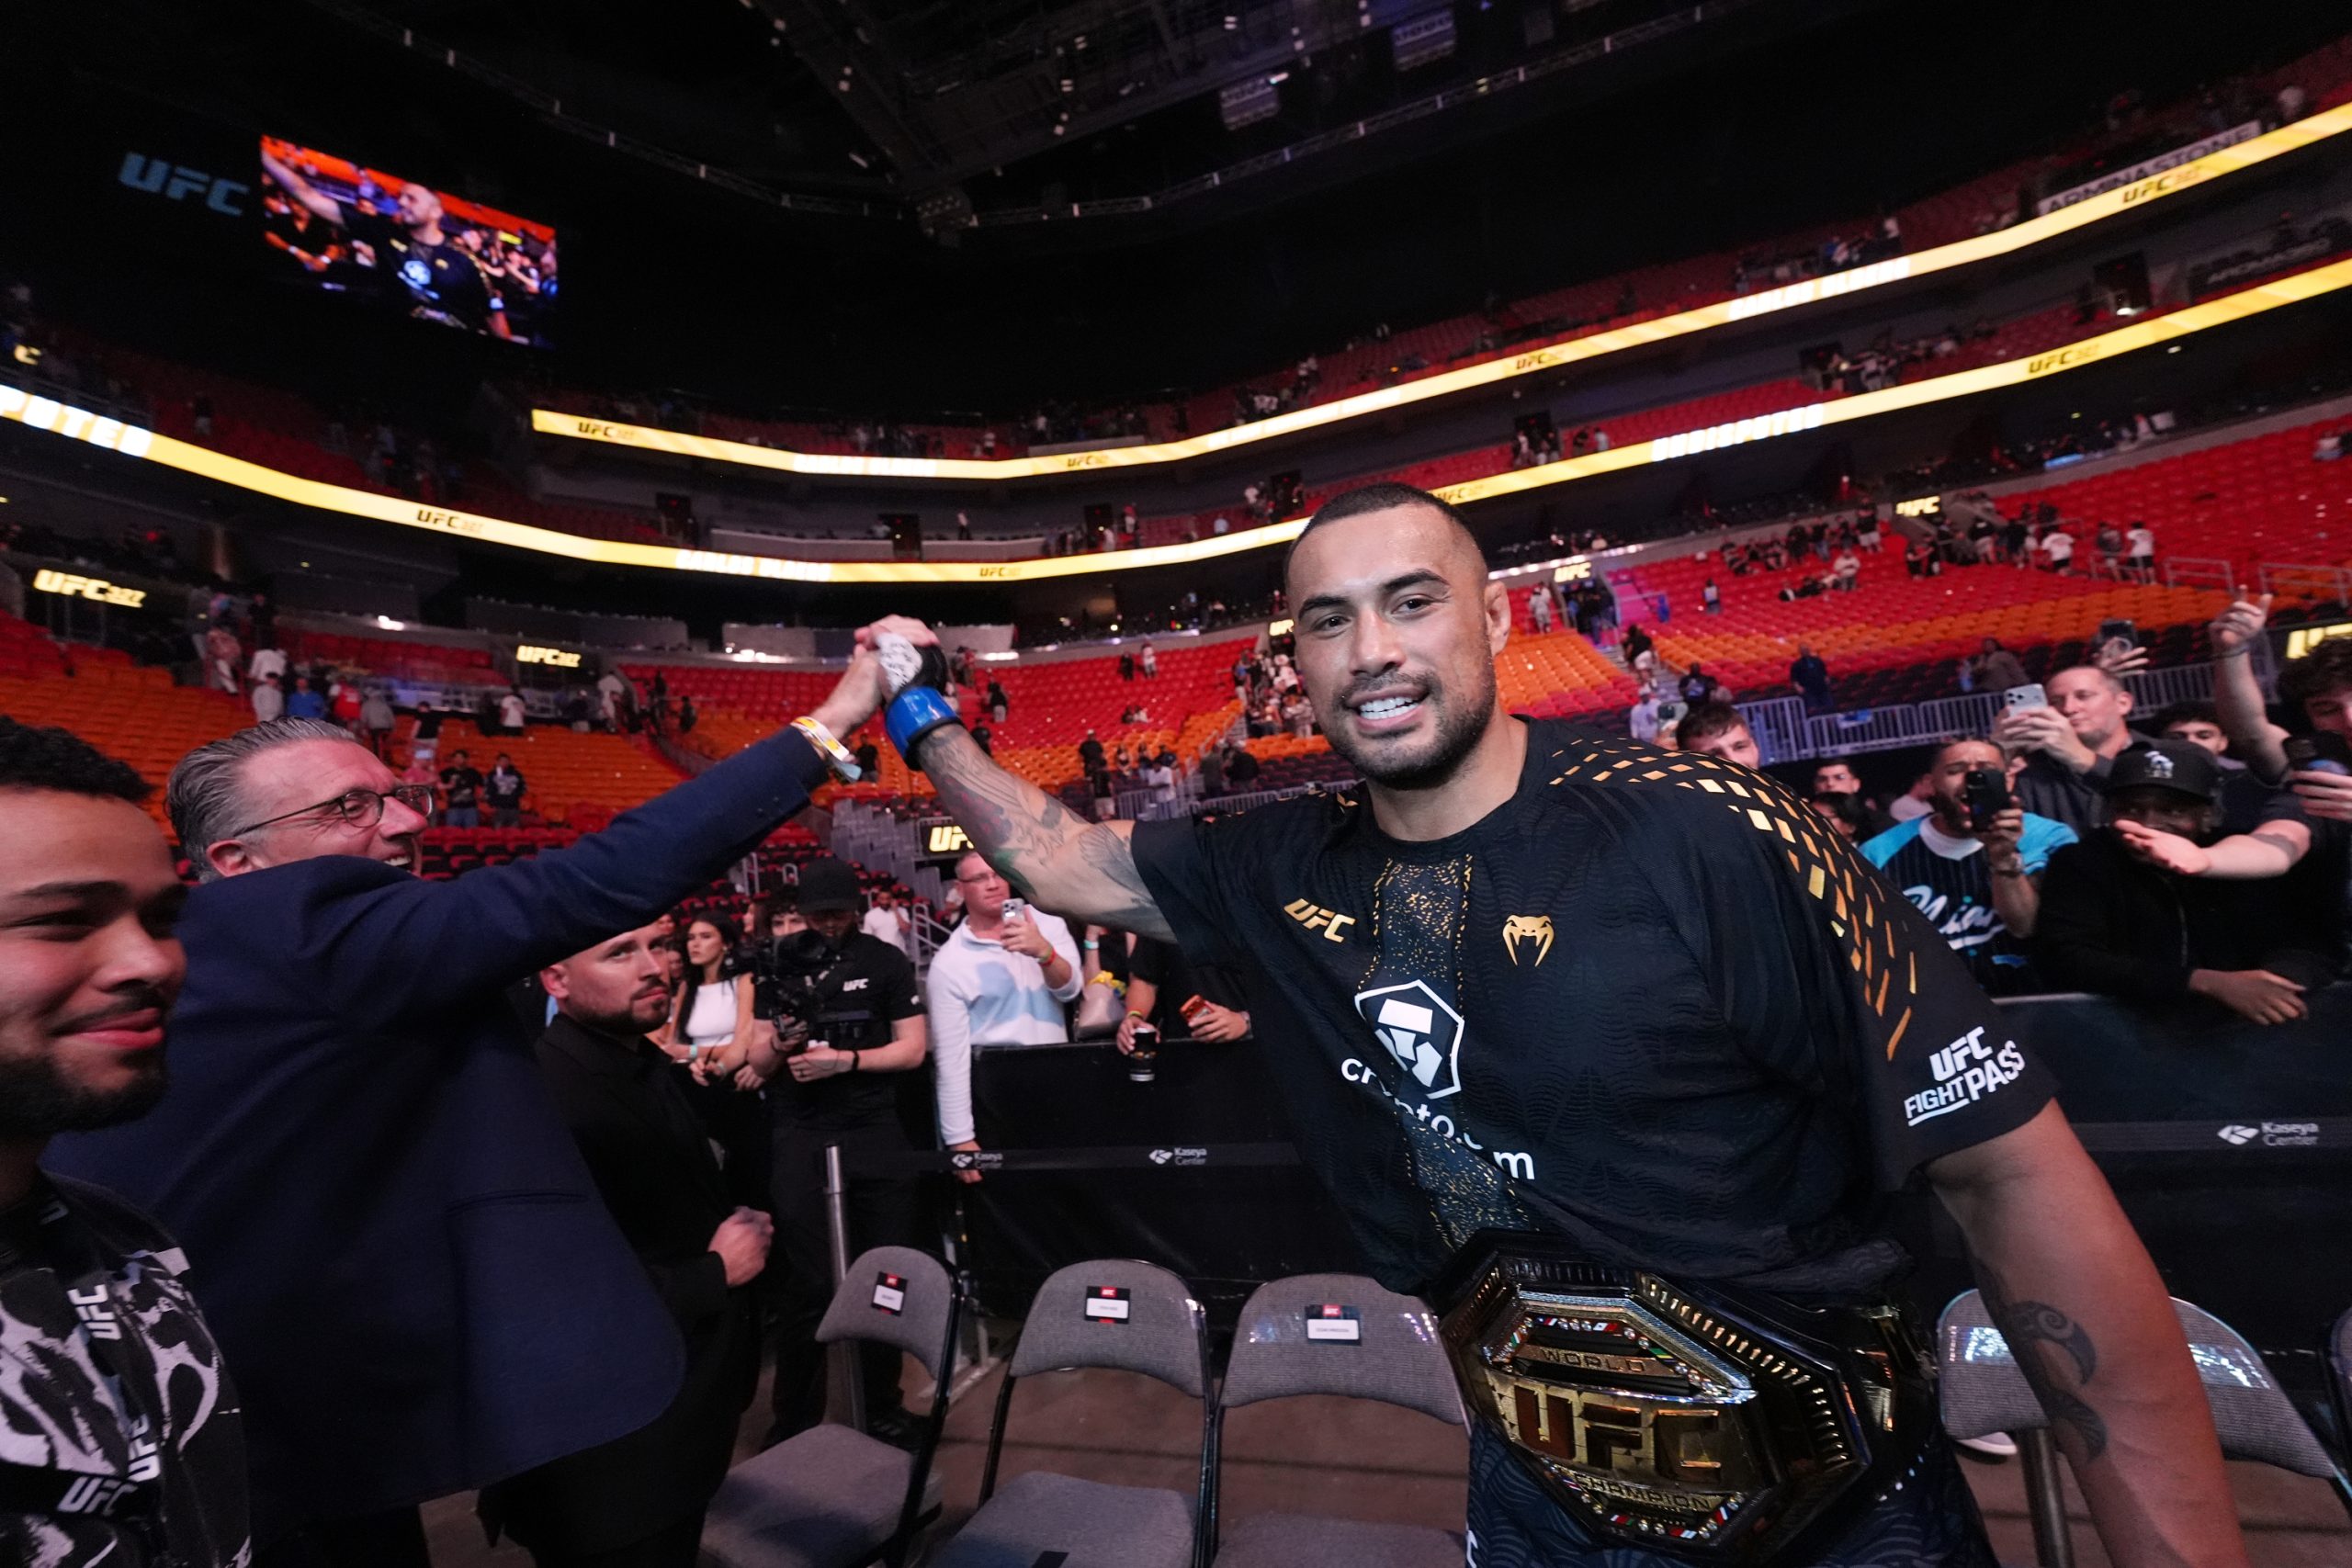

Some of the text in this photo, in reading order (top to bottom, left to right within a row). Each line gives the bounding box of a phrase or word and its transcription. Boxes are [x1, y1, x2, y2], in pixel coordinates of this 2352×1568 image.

[119, 151, 250, 217] UFC
[2122, 174, 2173, 204] UFC
[1516, 352, 1550, 370] UFC
[2029, 349, 2074, 374] UFC
[578, 421, 615, 438] UFC
[417, 509, 460, 530] UFC
[1554, 562, 1591, 582] UFC
[34, 569, 111, 602] UFC
[516, 645, 560, 665] UFC
[929, 825, 974, 852] UF
[1283, 897, 1356, 942] UFC
[842, 977, 869, 992] UFC
[1929, 1026, 1993, 1081] UFC
[1340, 1058, 1535, 1179] crto.m
[2261, 1122, 2319, 1135] Kaseya
[1174, 1147, 1207, 1157] Kaseya
[2262, 1134, 2318, 1146] Center
[67, 1284, 122, 1341] UFC
[1542, 1348, 1645, 1372] WORLD
[1515, 1383, 1722, 1482] UFC
[57, 1476, 140, 1517] UFC
[1573, 1472, 1711, 1508] CHAMPION
